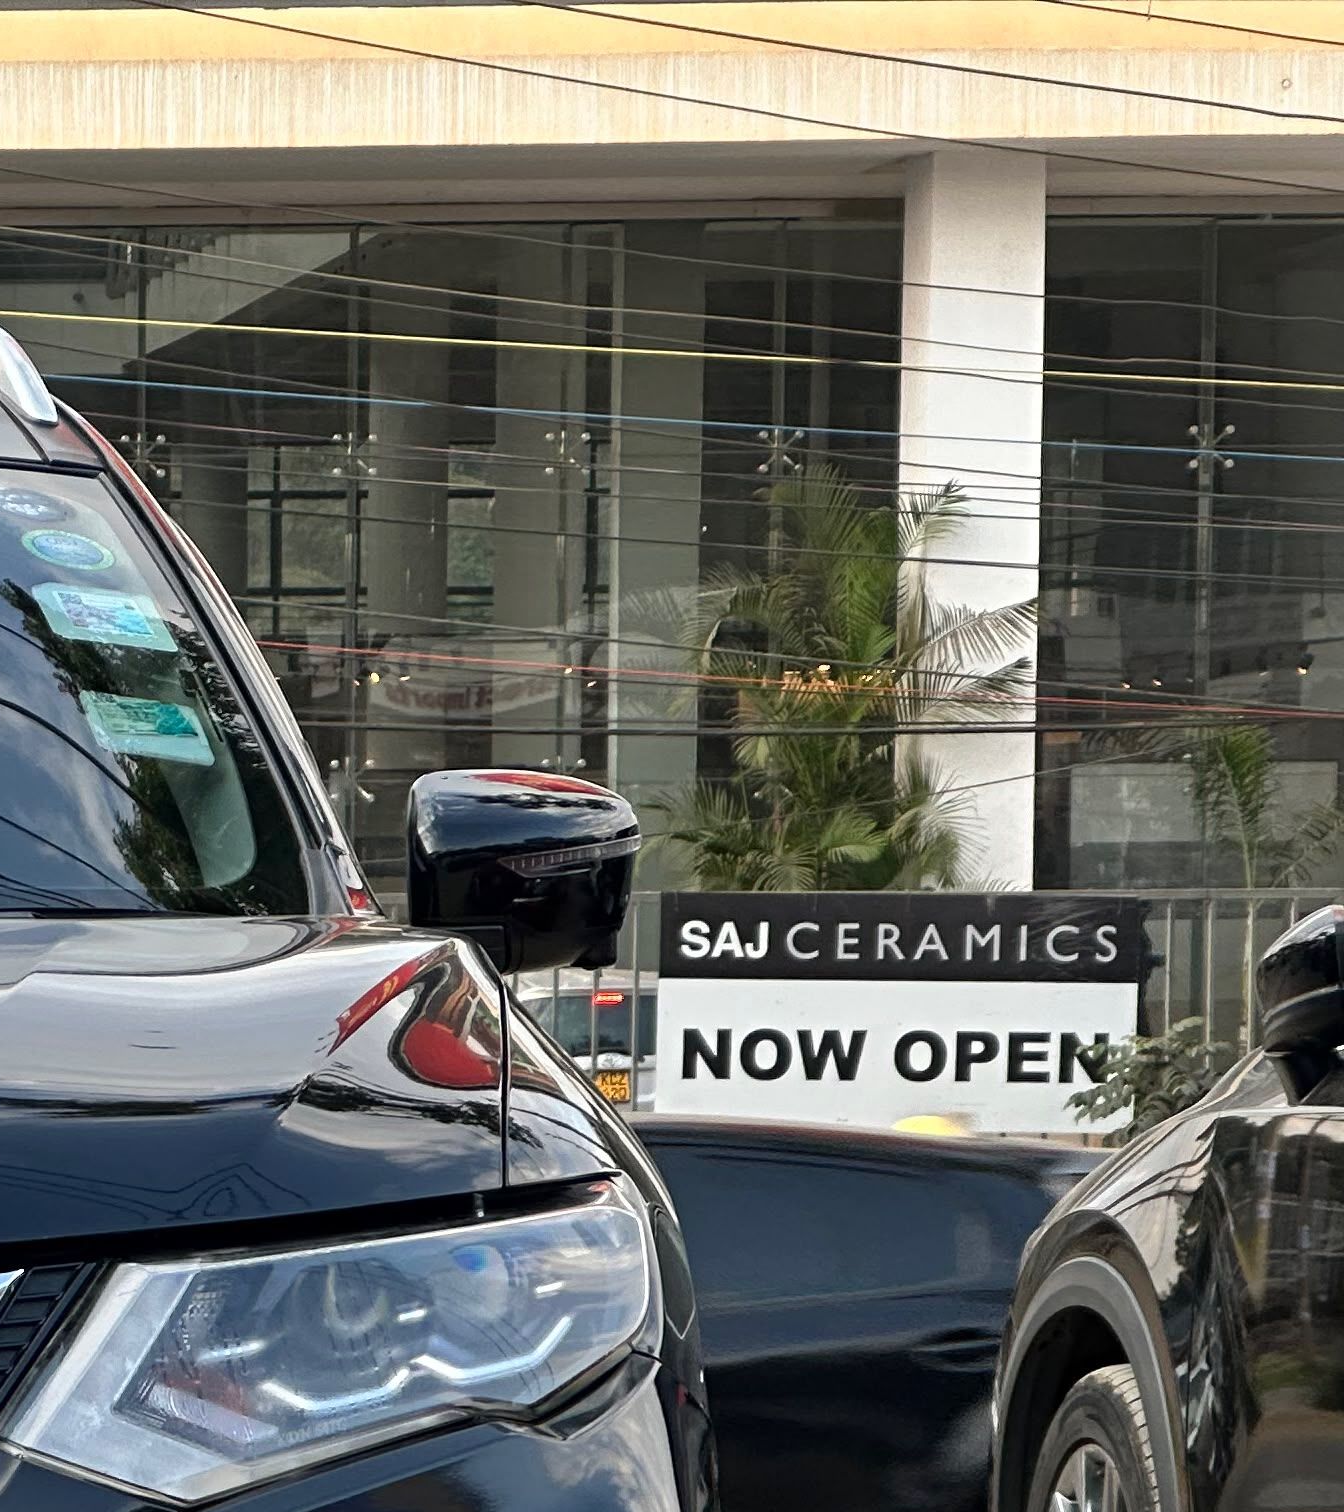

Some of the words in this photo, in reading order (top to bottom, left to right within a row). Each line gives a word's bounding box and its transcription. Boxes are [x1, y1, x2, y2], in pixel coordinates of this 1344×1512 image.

[680, 919, 770, 959] SAJ
[786, 921, 1119, 963] CERAMICS
[681, 1027, 868, 1082] NOW
[893, 1029, 1110, 1084] OPEN
